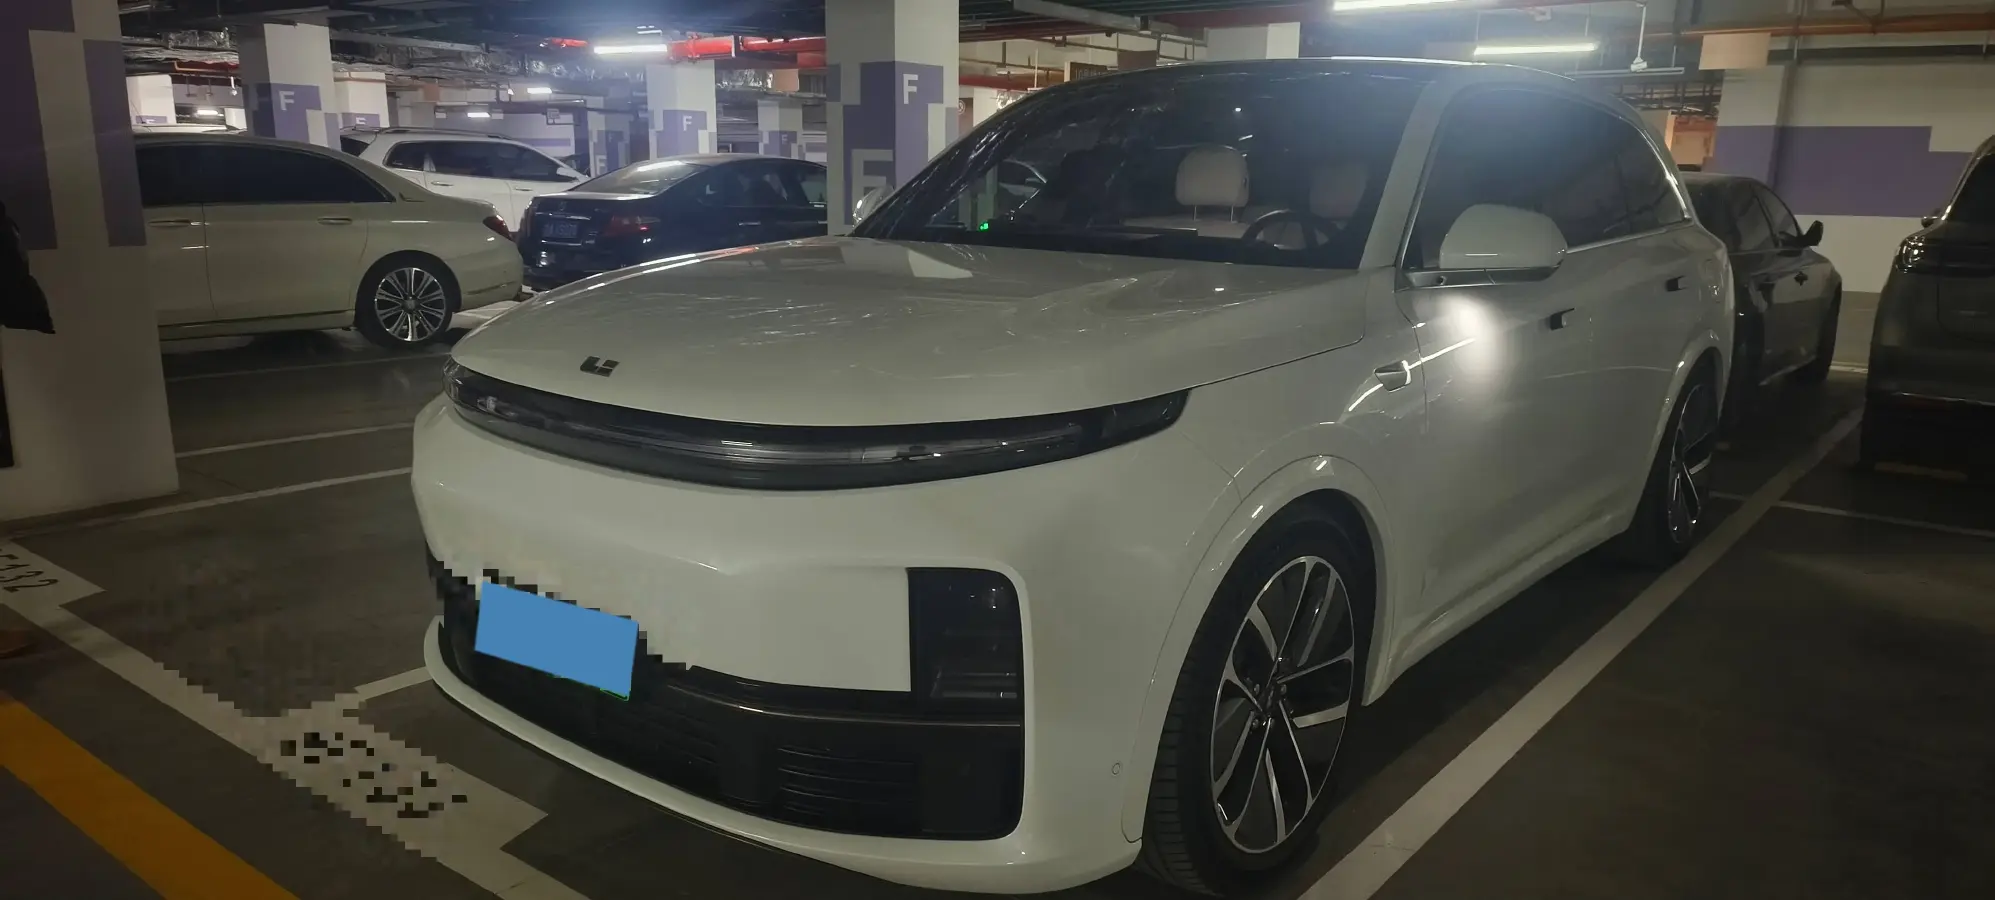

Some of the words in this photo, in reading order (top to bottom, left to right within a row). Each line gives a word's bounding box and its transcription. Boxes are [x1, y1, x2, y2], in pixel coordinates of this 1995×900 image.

[902, 74, 918, 104] F
[279, 91, 295, 110] F
[683, 115, 693, 131] F
[780, 134, 789, 145] F
[595, 155, 607, 176] F
[852, 149, 894, 210] F
